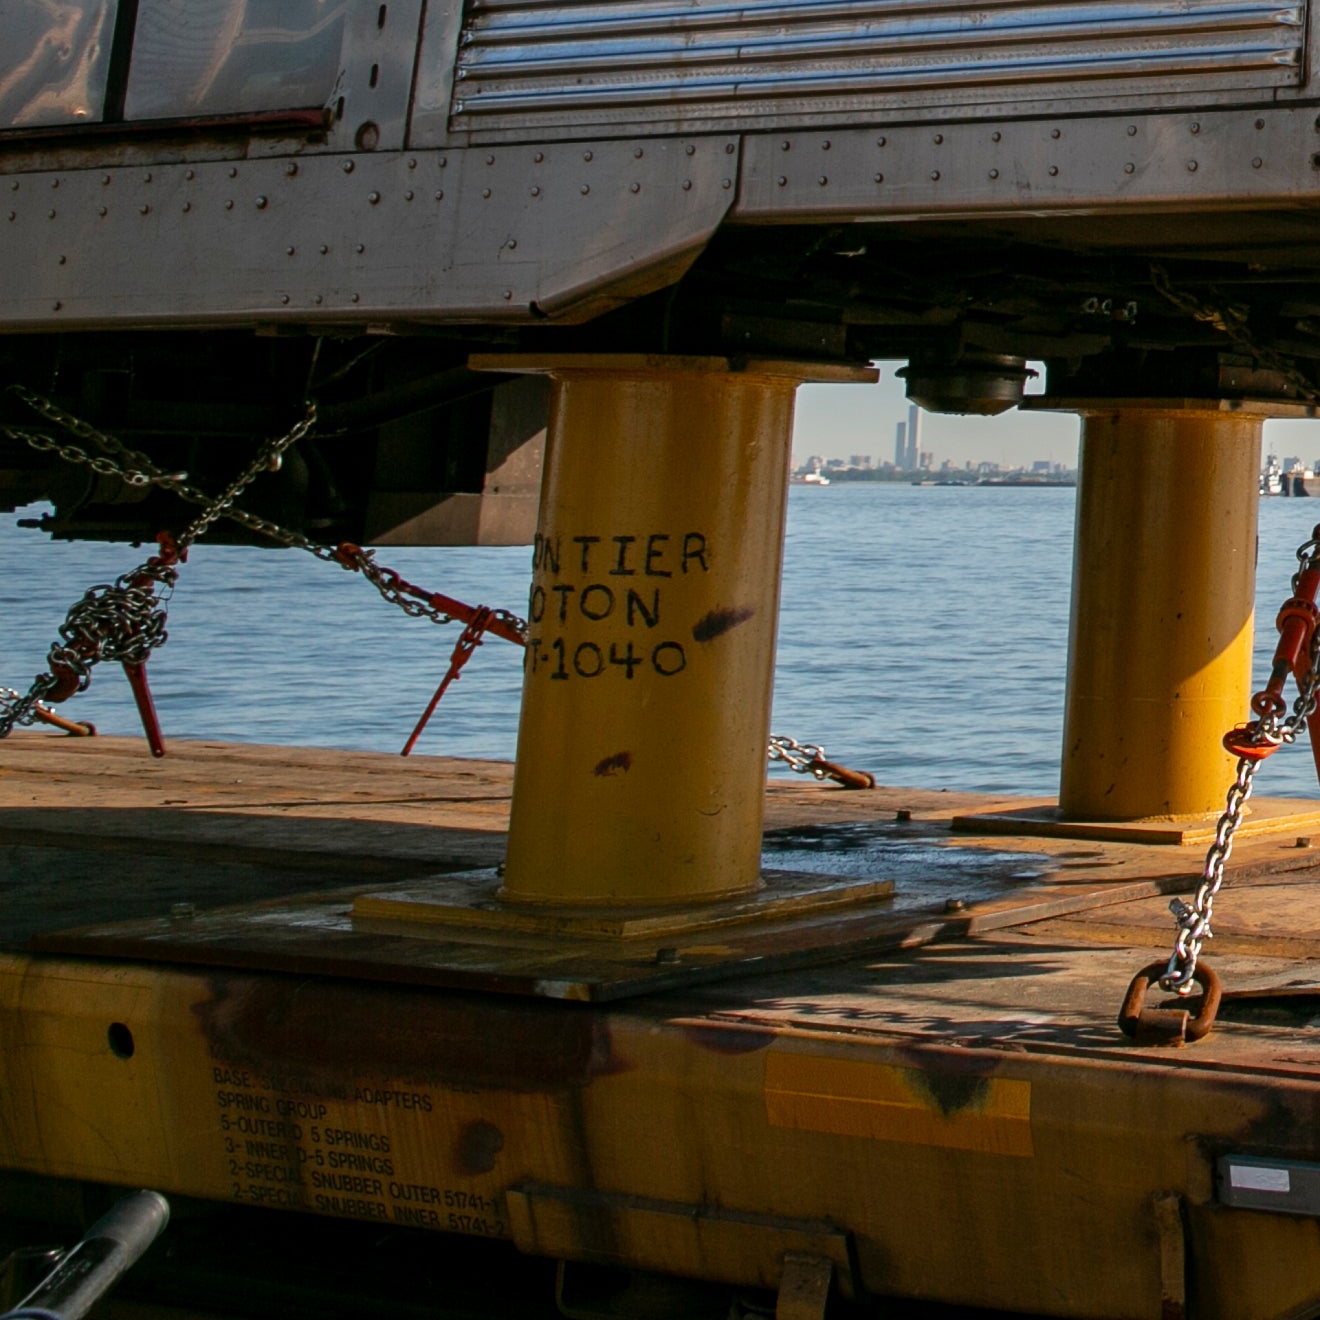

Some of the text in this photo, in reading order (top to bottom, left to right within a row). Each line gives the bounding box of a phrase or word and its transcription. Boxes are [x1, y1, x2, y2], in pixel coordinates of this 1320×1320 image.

[217, 1091, 327, 1120] SPRING GROUP
[355, 1087, 433, 1112] ADAPTERS
[324, 1128, 390, 1153] SPRINGS
[328, 1150, 394, 1176] SPRINGS
[311, 1171, 384, 1196] SNUBBER
[388, 1182, 441, 1205] OUTER
[315, 1194, 388, 1220] SNUBBER
[393, 1205, 441, 1227] INNER
